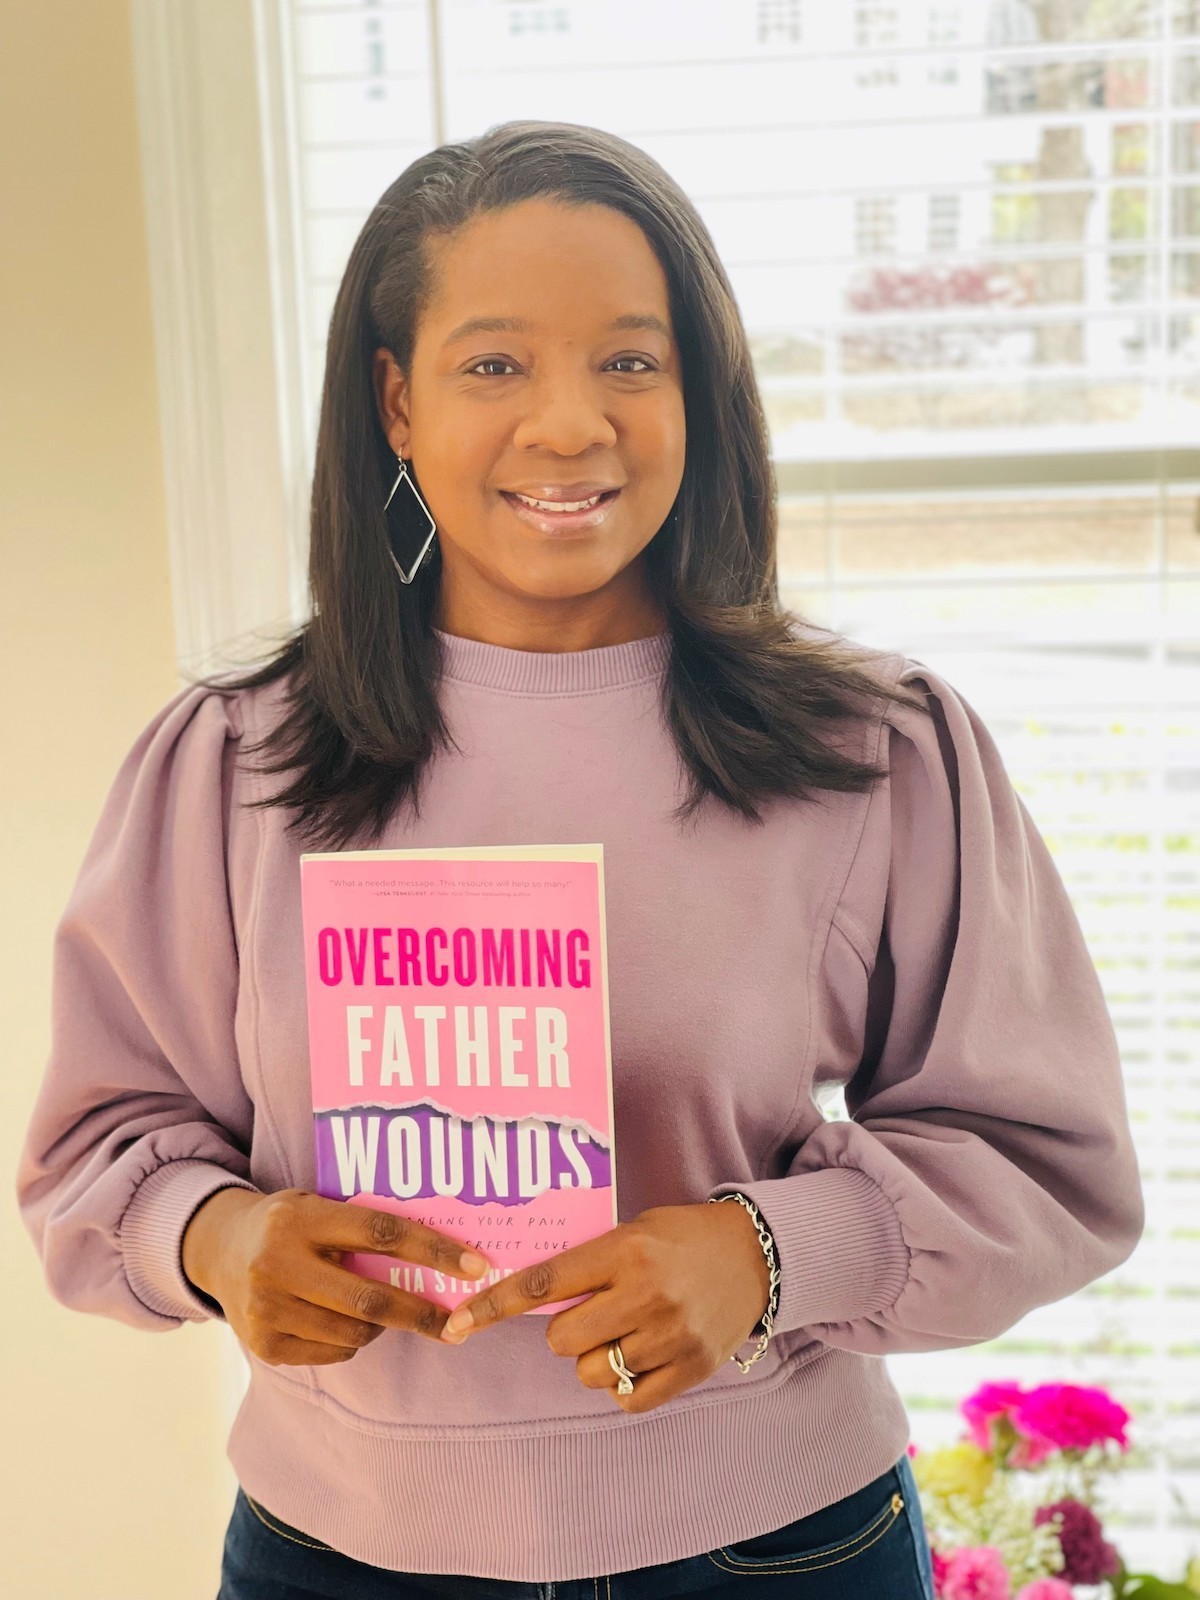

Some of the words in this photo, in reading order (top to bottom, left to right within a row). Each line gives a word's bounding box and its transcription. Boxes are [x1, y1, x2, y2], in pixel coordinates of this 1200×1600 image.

[329, 879, 356, 887] "What
[365, 879, 396, 887] needed
[458, 880, 494, 888] resource
[512, 880, 530, 888] help
[318, 927, 591, 988] OVERCOMING
[346, 1005, 571, 1088] FATHER
[330, 1115, 593, 1198] WOUNDS
[478, 1216, 514, 1226] YOUR
[528, 1217, 567, 1227] PAIN
[534, 1240, 569, 1250] LOVE
[390, 1267, 425, 1293] KIA
